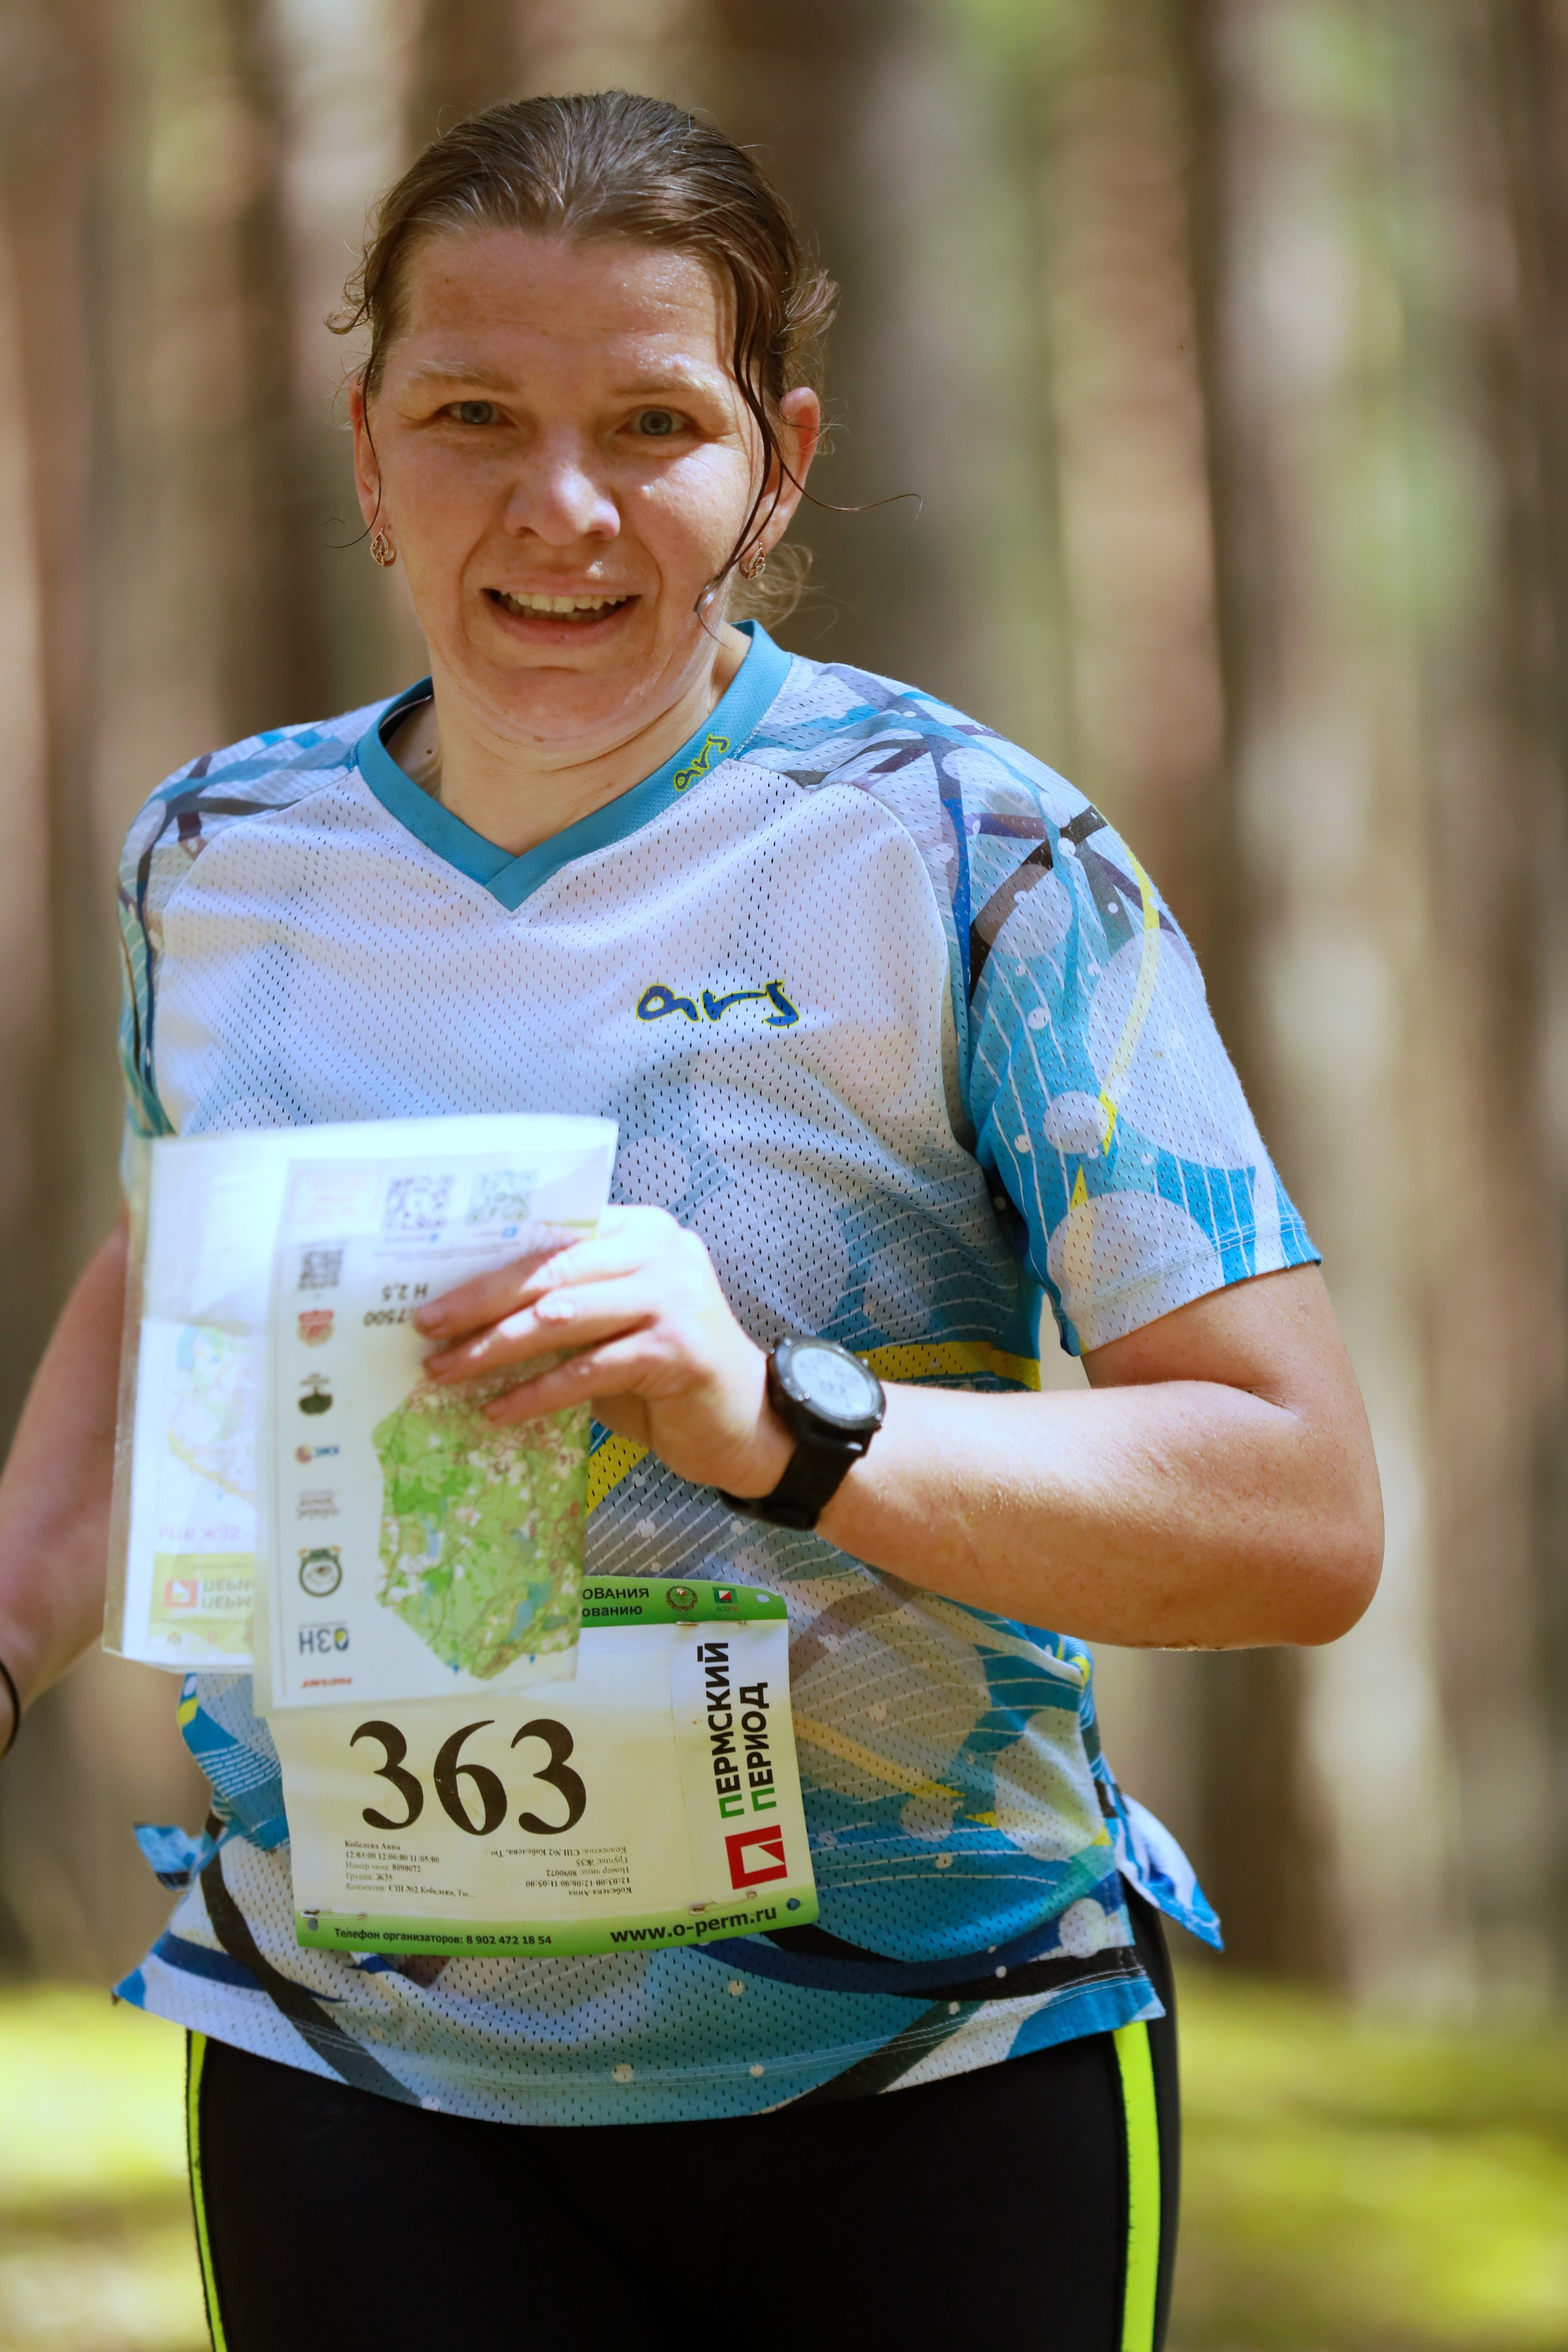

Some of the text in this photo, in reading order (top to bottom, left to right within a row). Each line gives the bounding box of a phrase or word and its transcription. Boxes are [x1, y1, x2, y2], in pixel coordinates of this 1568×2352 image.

[697, 1643, 745, 1819] ПЕРМСКИЙ
[739, 1682, 777, 1812] ПЕРИОД
[350, 1719, 587, 1836] 363
[345, 1841, 379, 1850] Кобелева
[345, 1851, 440, 1863] 12:03:00 12:06:00 11:05:00
[346, 1861, 370, 1871] Номер
[392, 1864, 421, 1872] 8090072
[593, 1887, 632, 1895] Кобелева
[610, 1907, 777, 1943] www.o-perm.ru
[334, 1928, 552, 1945] Телефон организаторов: 8 902 472 18 54
